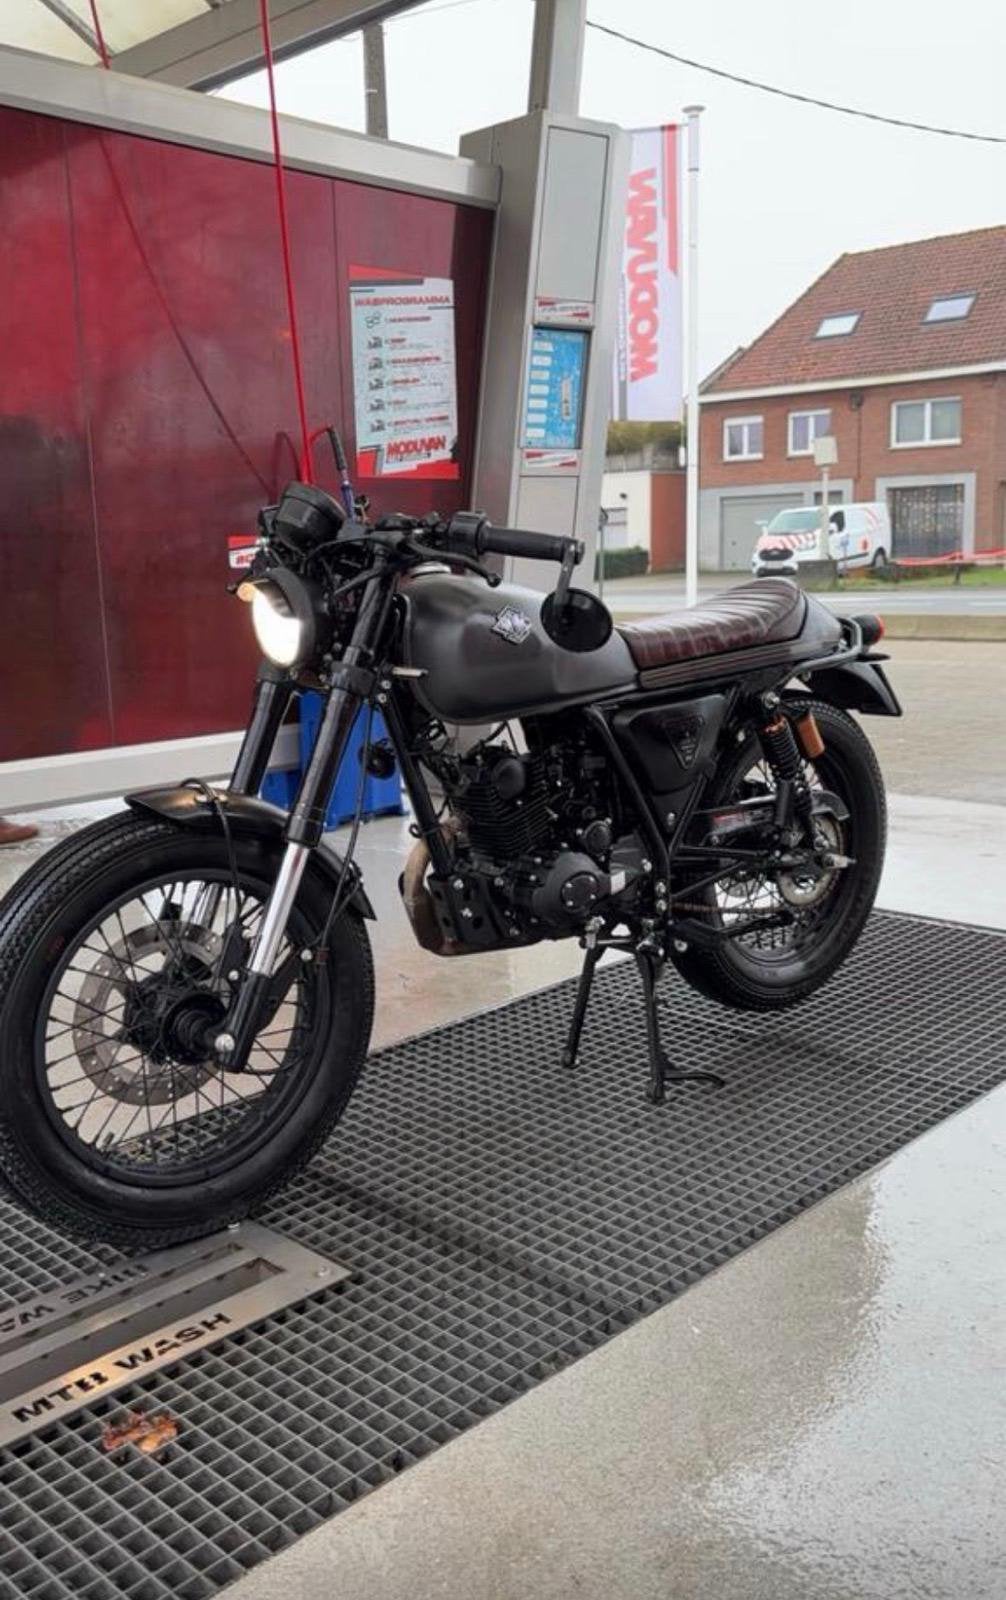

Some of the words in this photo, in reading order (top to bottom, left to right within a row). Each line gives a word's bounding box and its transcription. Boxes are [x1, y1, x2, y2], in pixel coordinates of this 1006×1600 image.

[387, 435, 446, 457] MODUVAN
[12, 1371, 109, 1422] MTB
[114, 1313, 232, 1371] WASH
